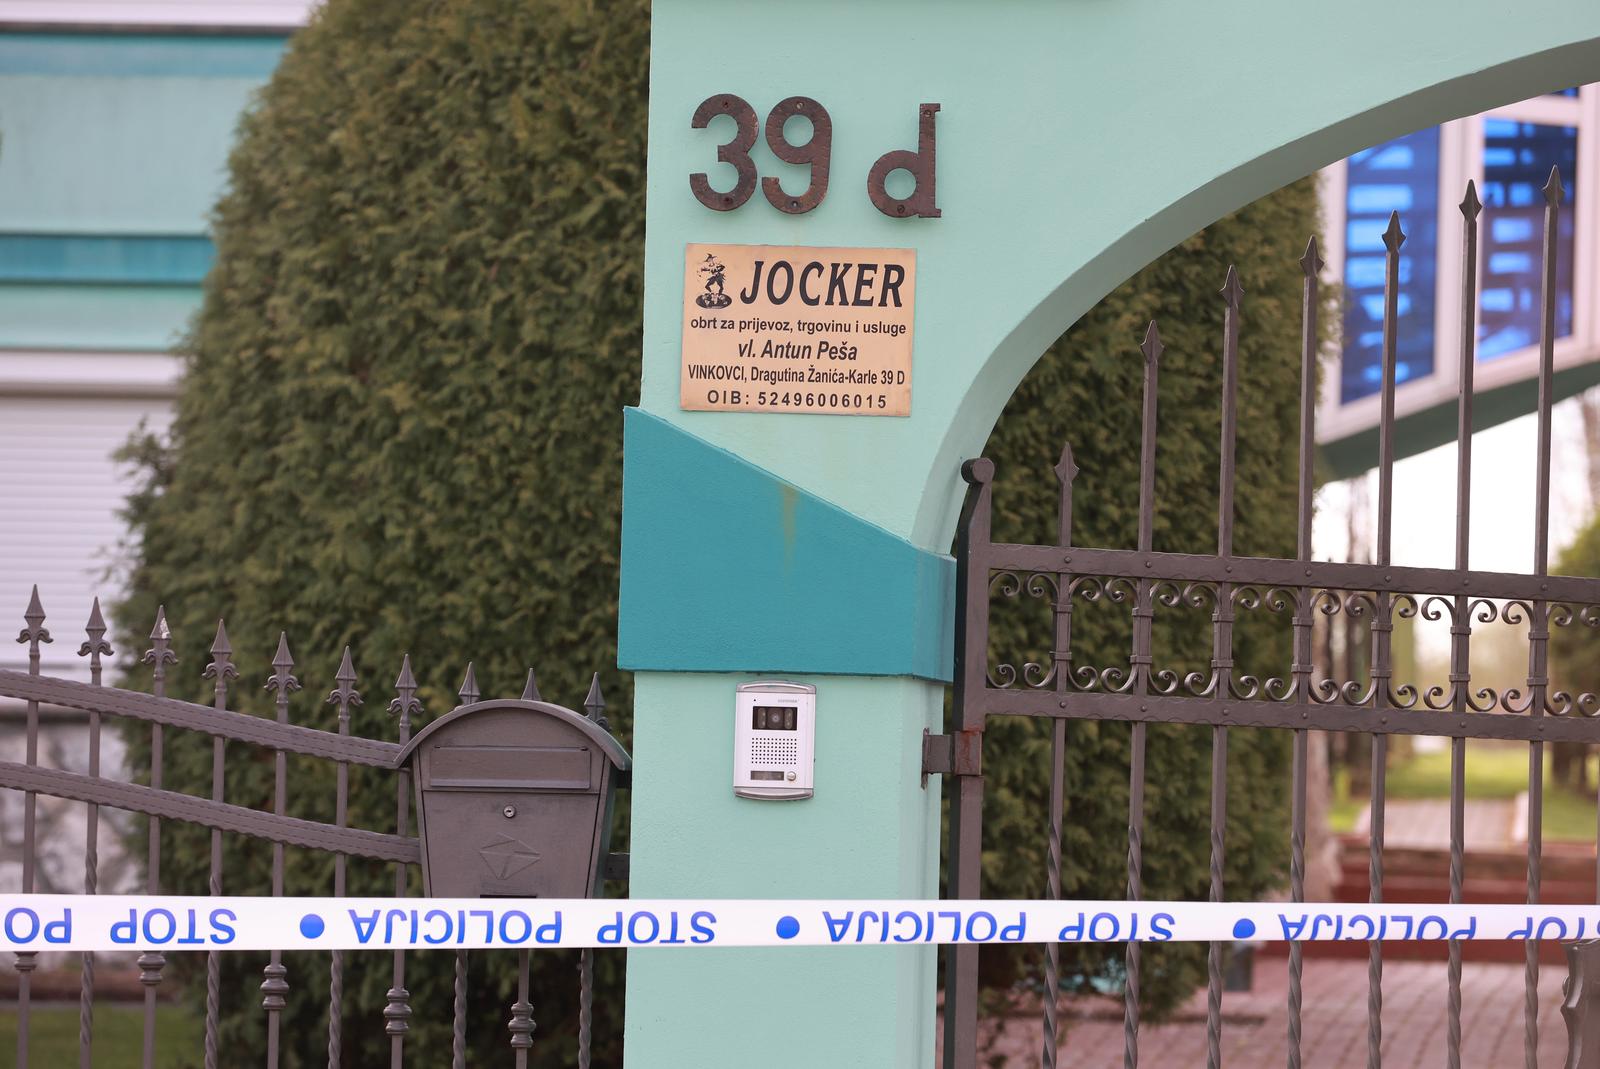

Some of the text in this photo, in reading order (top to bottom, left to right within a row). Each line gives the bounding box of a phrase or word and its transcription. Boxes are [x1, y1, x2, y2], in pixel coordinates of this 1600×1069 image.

[689, 93, 942, 218] 39 d
[740, 260, 906, 308] JOCKER
[690, 316, 907, 337] obrt za prijevoz, trgovinu i usluge
[738, 339, 858, 361] vl. Antun Peša
[688, 364, 905, 386] VINKOVCI, Dragutina Žanića-Karle 39 D
[707, 389, 887, 409] OIB: 52496006015
[109, 907, 237, 945] STOP
[348, 908, 717, 945] STOP POLICIJA
[822, 910, 1176, 943] STOP POLICIJA
[1278, 913, 1600, 941] TOP POLICIJA
